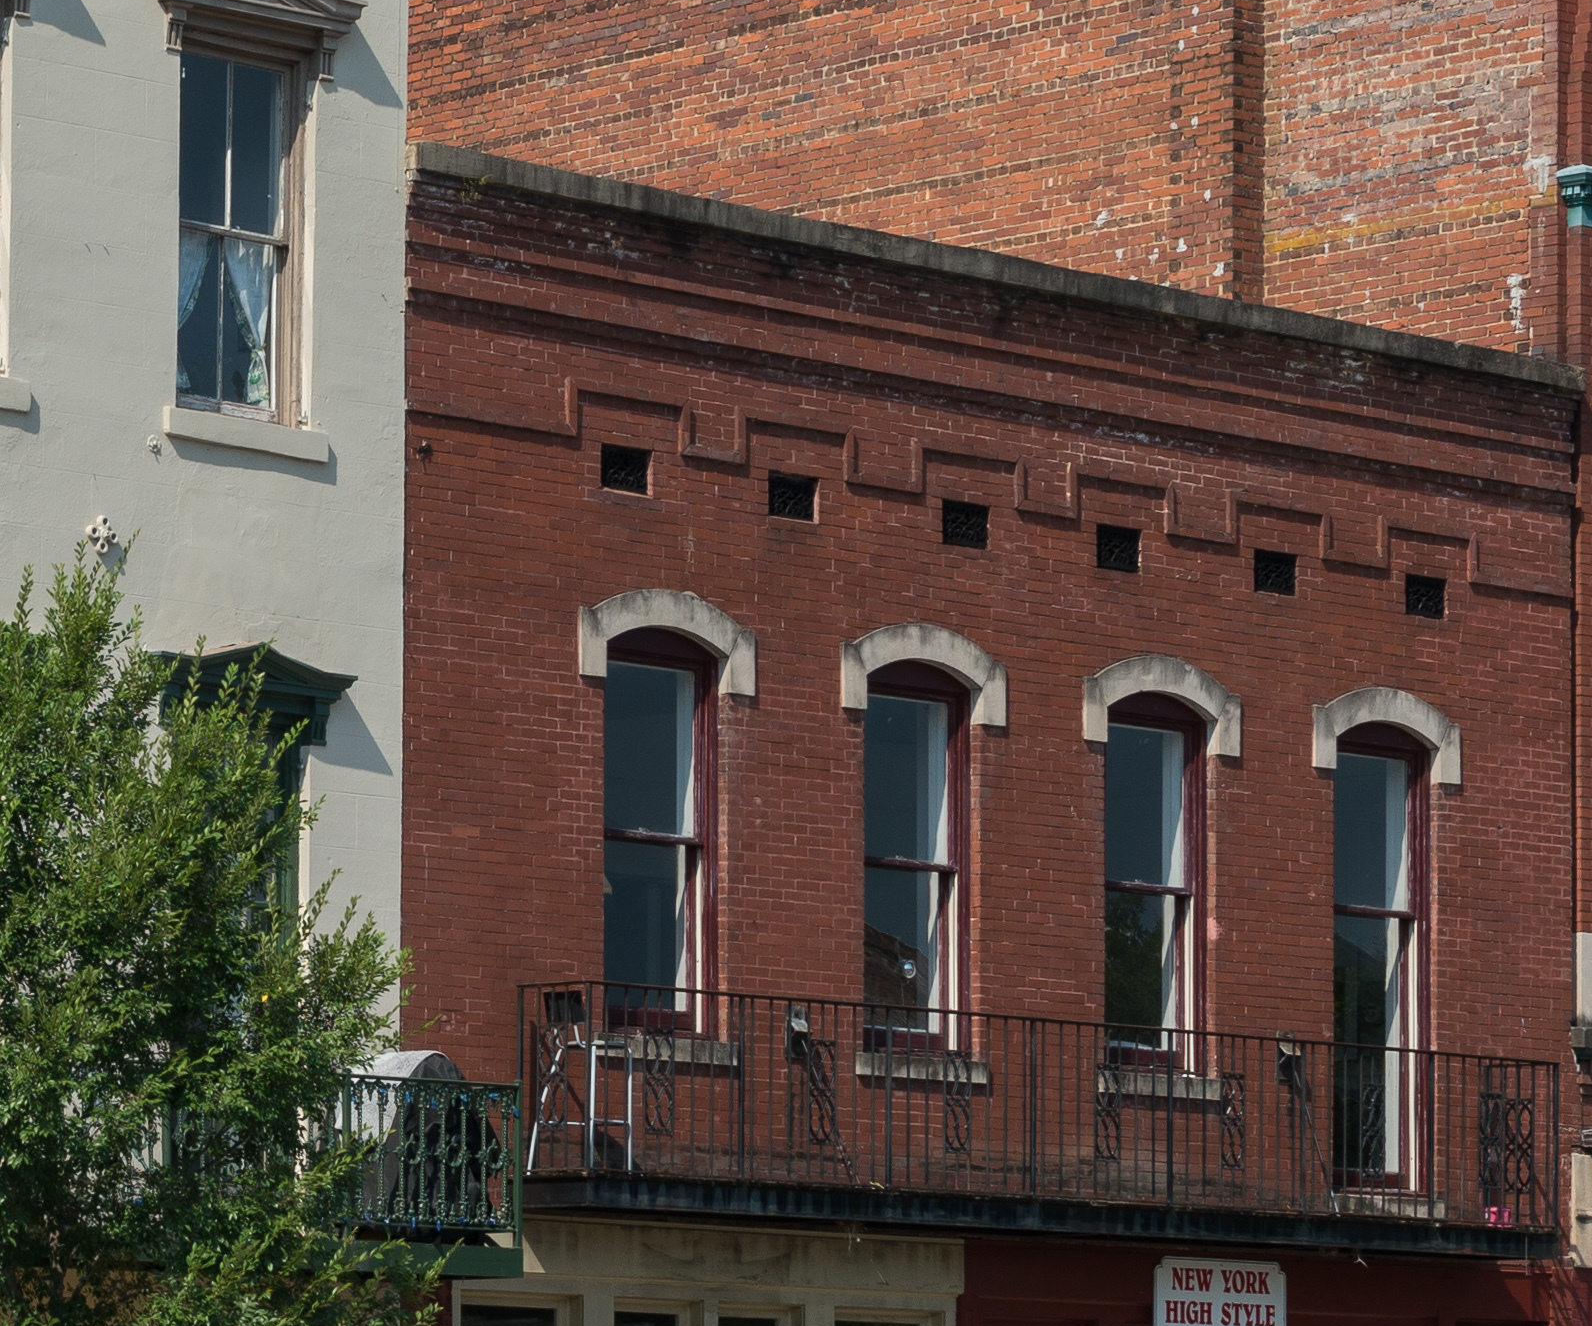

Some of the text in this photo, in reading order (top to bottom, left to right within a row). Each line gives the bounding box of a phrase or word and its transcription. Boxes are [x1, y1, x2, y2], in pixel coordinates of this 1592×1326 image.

[1171, 1266, 1271, 1295] NEW YORK
[1164, 1300, 1213, 1325] HIGH
